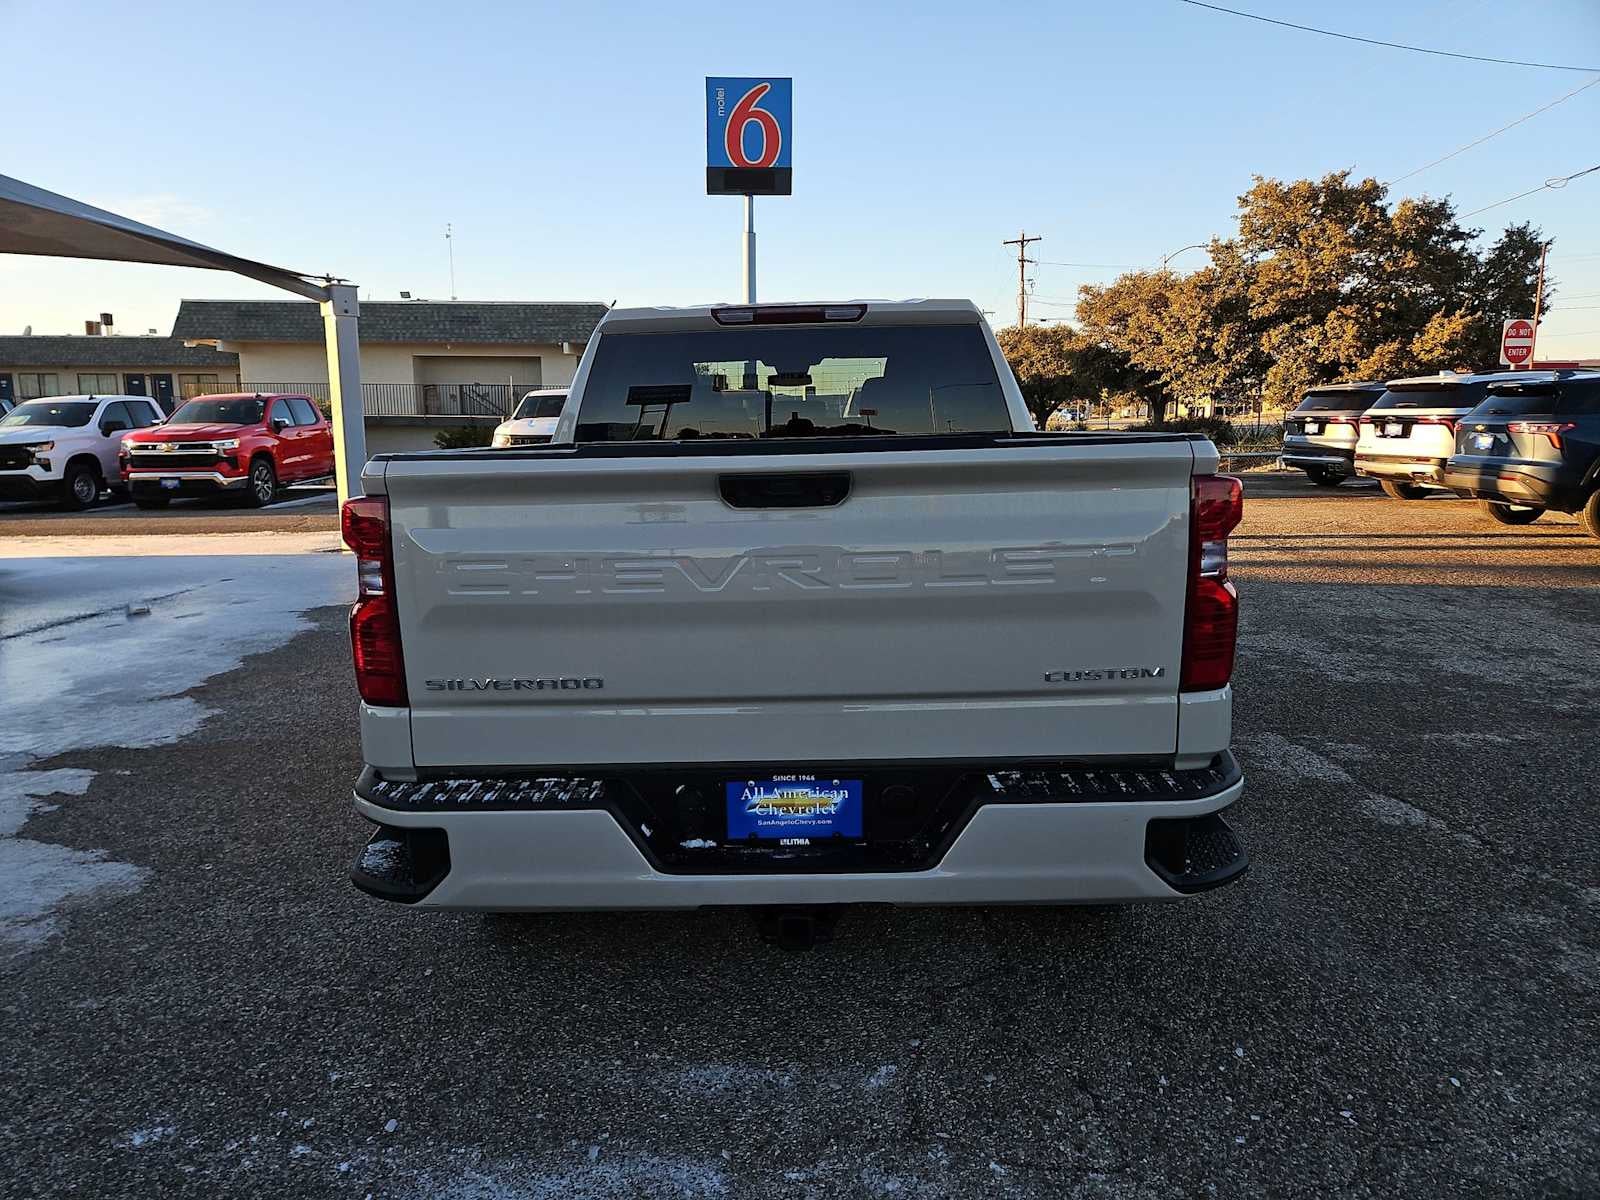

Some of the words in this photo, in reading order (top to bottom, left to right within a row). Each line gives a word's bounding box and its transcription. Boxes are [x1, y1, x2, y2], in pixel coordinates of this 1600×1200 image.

[716, 87, 725, 117] motel
[724, 82, 782, 168] 6
[1507, 328, 1516, 336] DO
[1519, 328, 1531, 336] NOT
[1508, 348, 1527, 356] ENTER
[445, 543, 1137, 594] CHEVROLET
[1044, 667, 1166, 683] CUSTOM
[424, 678, 605, 692] SILVERADO
[741, 786, 764, 800] All
[772, 786, 849, 799] American
[755, 803, 836, 816] Chevrolet
